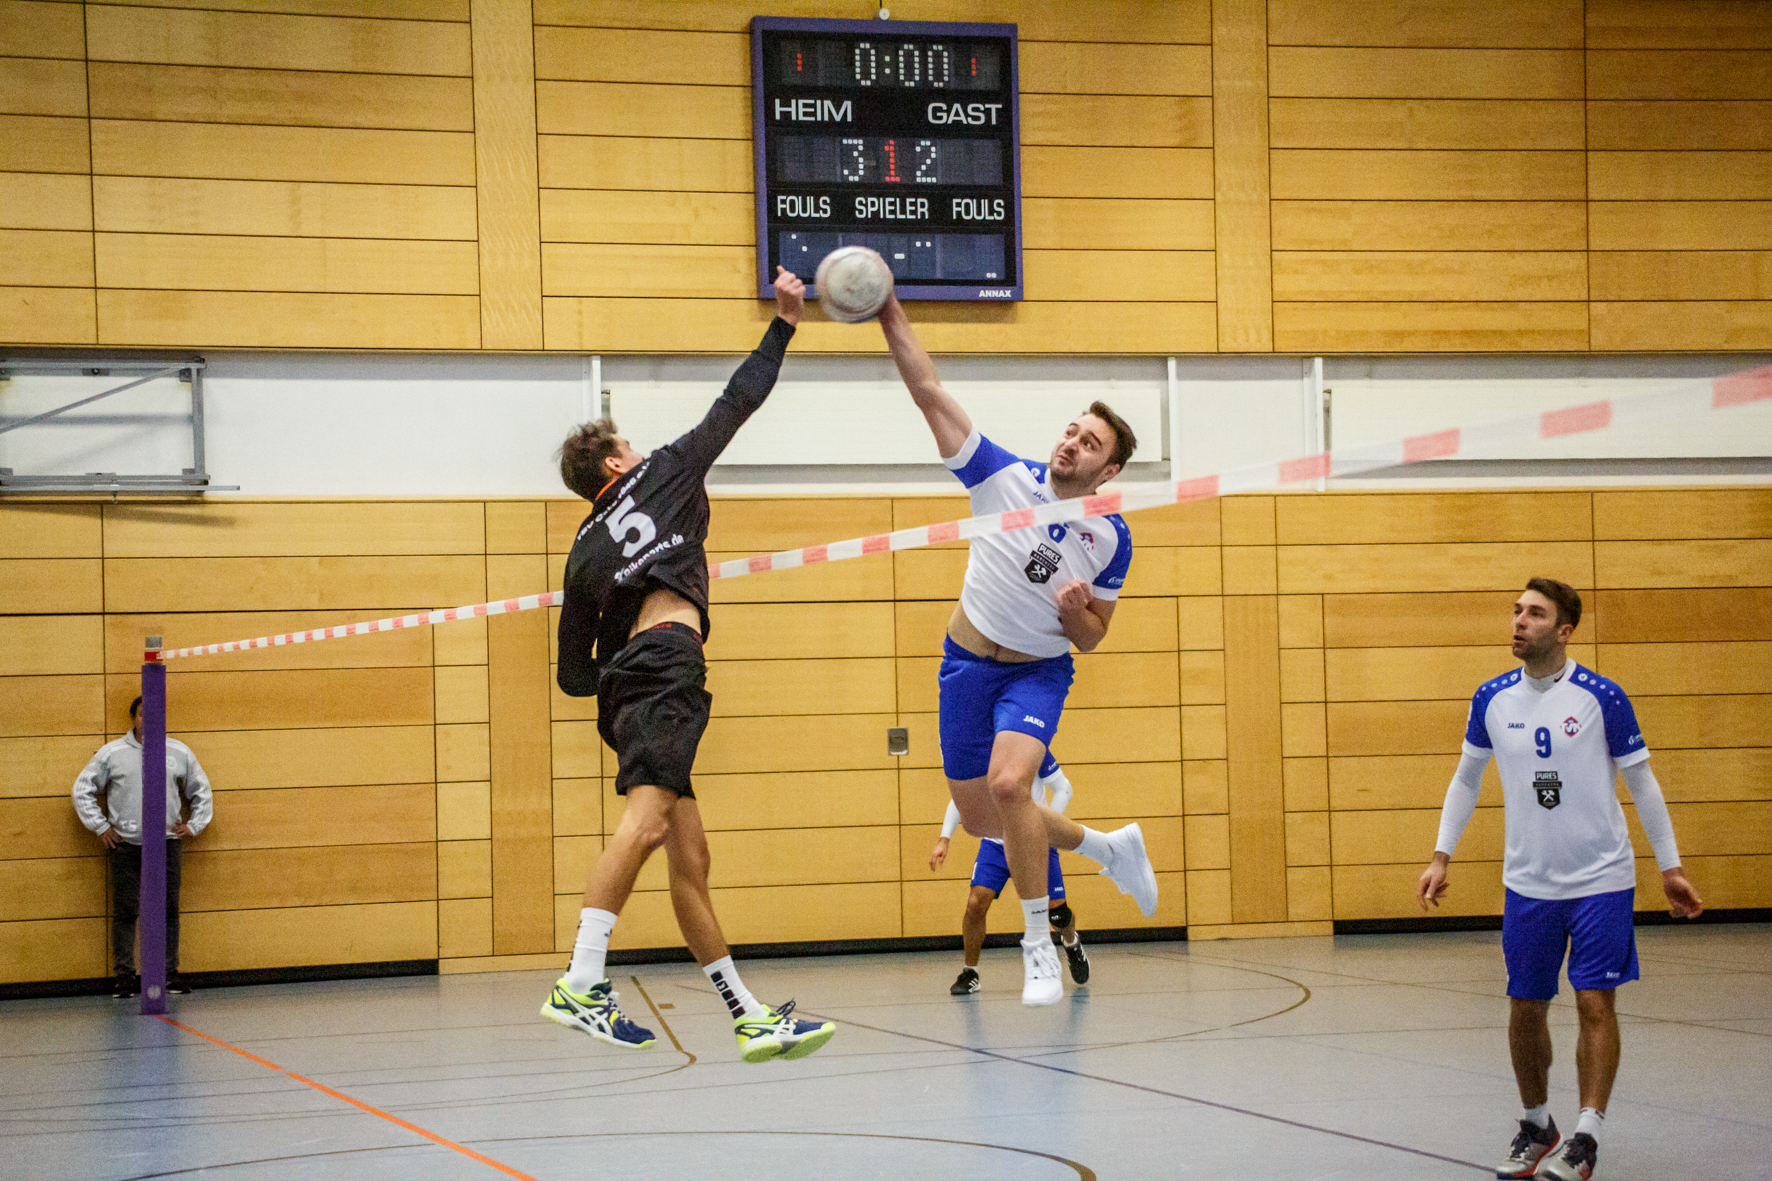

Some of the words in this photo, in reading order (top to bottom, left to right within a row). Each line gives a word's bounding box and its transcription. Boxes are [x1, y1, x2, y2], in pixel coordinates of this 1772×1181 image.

[854, 43, 949, 88] 0:00
[775, 98, 852, 122] HEIM
[927, 102, 1002, 125] GAST
[842, 138, 864, 182] 3
[884, 140, 900, 182] 1
[915, 140, 937, 183] 2
[777, 195, 831, 218] FOULS
[855, 197, 929, 219] SPIELER
[952, 198, 1005, 221] FOULS
[979, 289, 1012, 298] ANNAX
[605, 495, 656, 558] 5
[1039, 545, 1060, 563] PURES
[1023, 715, 1045, 728] JAKO
[1534, 726, 1552, 759] 9
[1536, 772, 1557, 780] PURES
